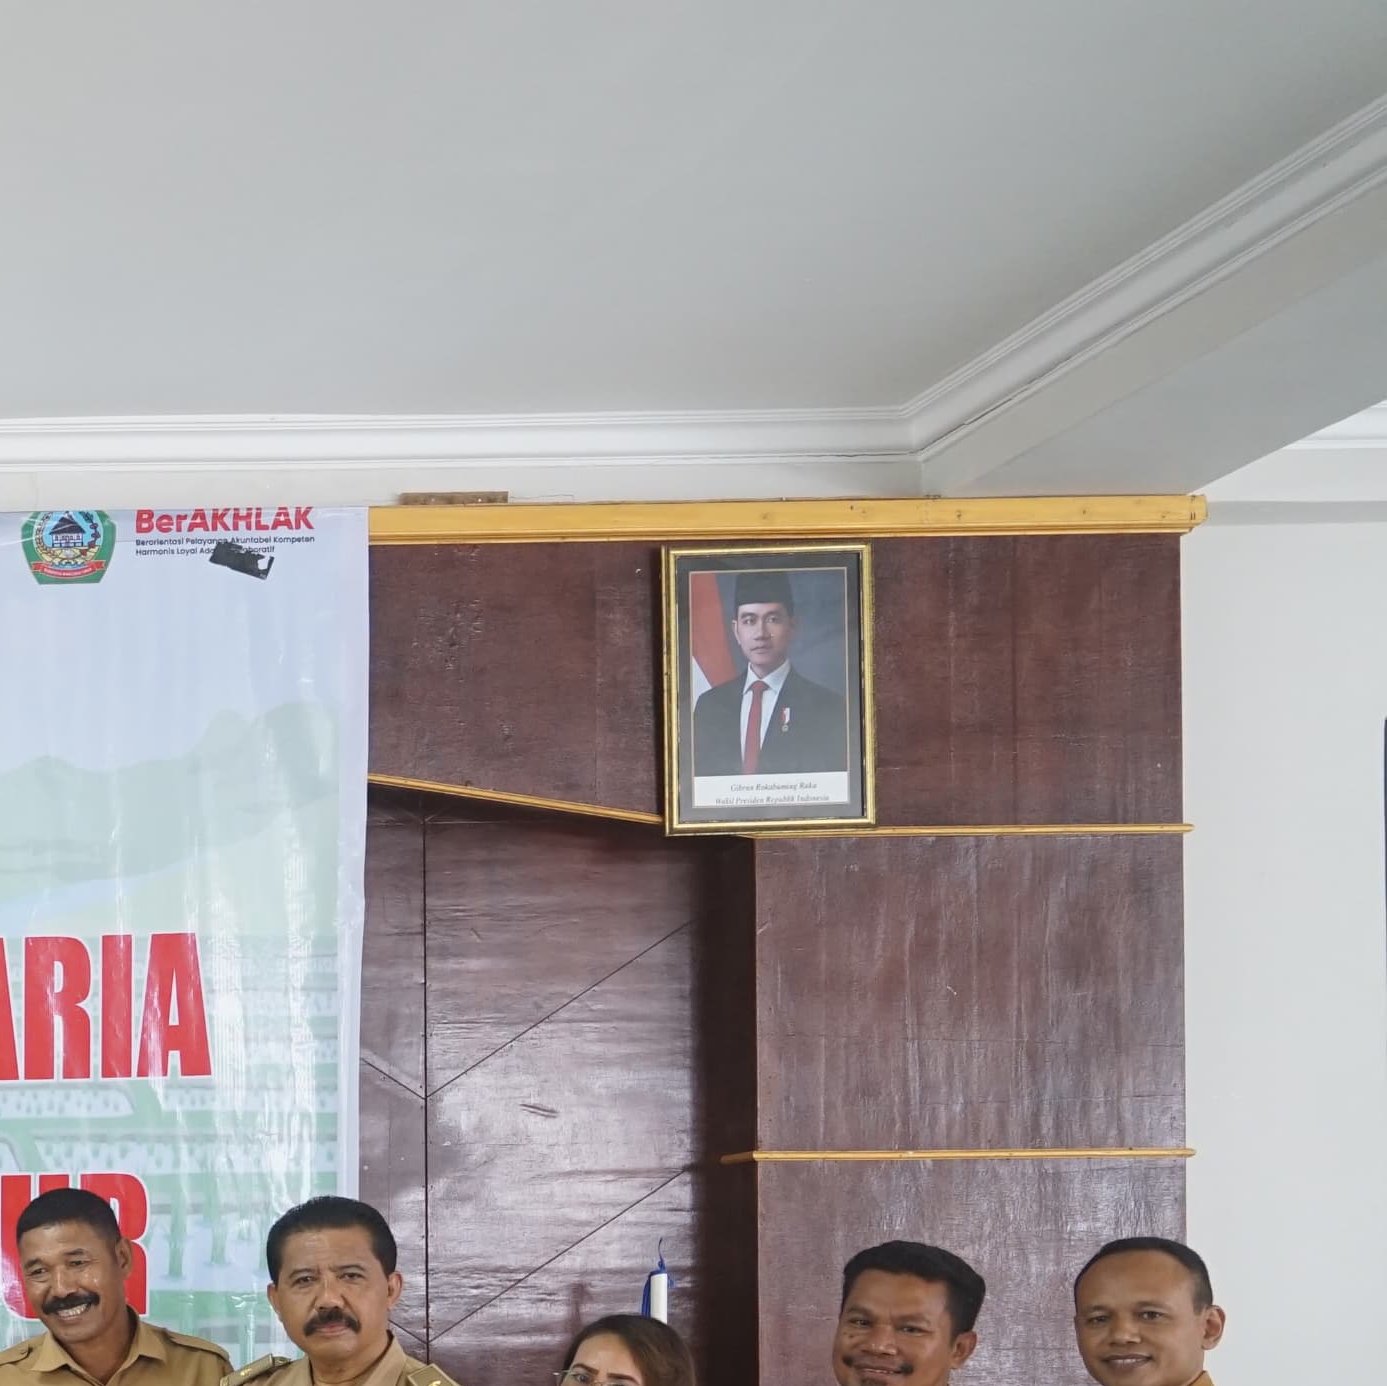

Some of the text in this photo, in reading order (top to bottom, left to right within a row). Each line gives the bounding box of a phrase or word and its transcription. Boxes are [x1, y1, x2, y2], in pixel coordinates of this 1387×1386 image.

[135, 507, 315, 533] BerAKHLAK
[136, 538, 184, 546] Berorientasi
[230, 535, 272, 544] Akuntabel
[273, 535, 315, 545] Kompeten
[135, 548, 175, 556] Harmonis
[177, 548, 197, 557] Loyal
